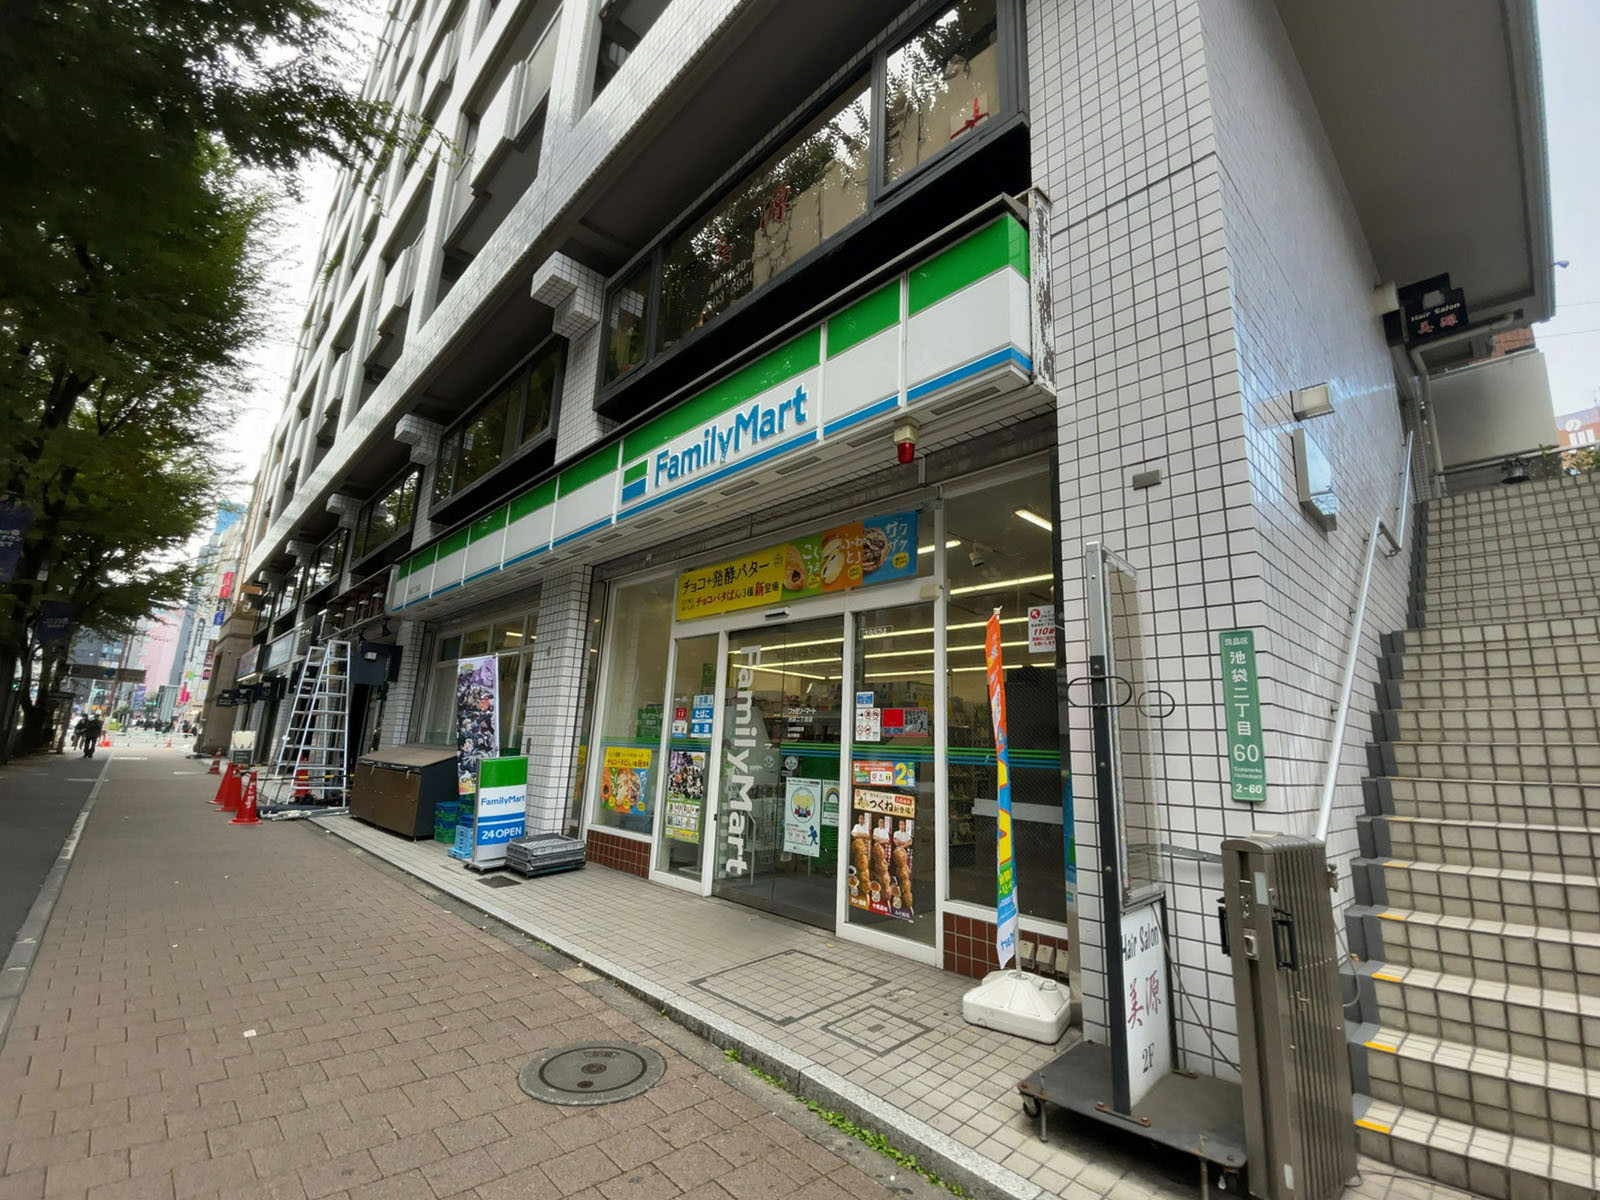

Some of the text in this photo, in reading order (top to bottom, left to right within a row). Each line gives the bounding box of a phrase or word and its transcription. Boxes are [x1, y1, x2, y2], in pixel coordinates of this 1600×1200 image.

[1411, 303, 1461, 322] Hair Salon
[654, 384, 808, 487] FamilyMart
[1229, 651, 1252, 736] 池袋二丁目
[726, 645, 762, 876] FamilyMart
[1233, 744, 1260, 762] 60
[895, 762, 907, 786] 2
[480, 794, 525, 806] FamilyMart
[1236, 783, 1263, 794] 2-60
[869, 799, 893, 812] つくね
[1122, 922, 1160, 962] Hair Salon
[1127, 969, 1162, 1030] 美源
[1142, 1042, 1155, 1074] 2F
